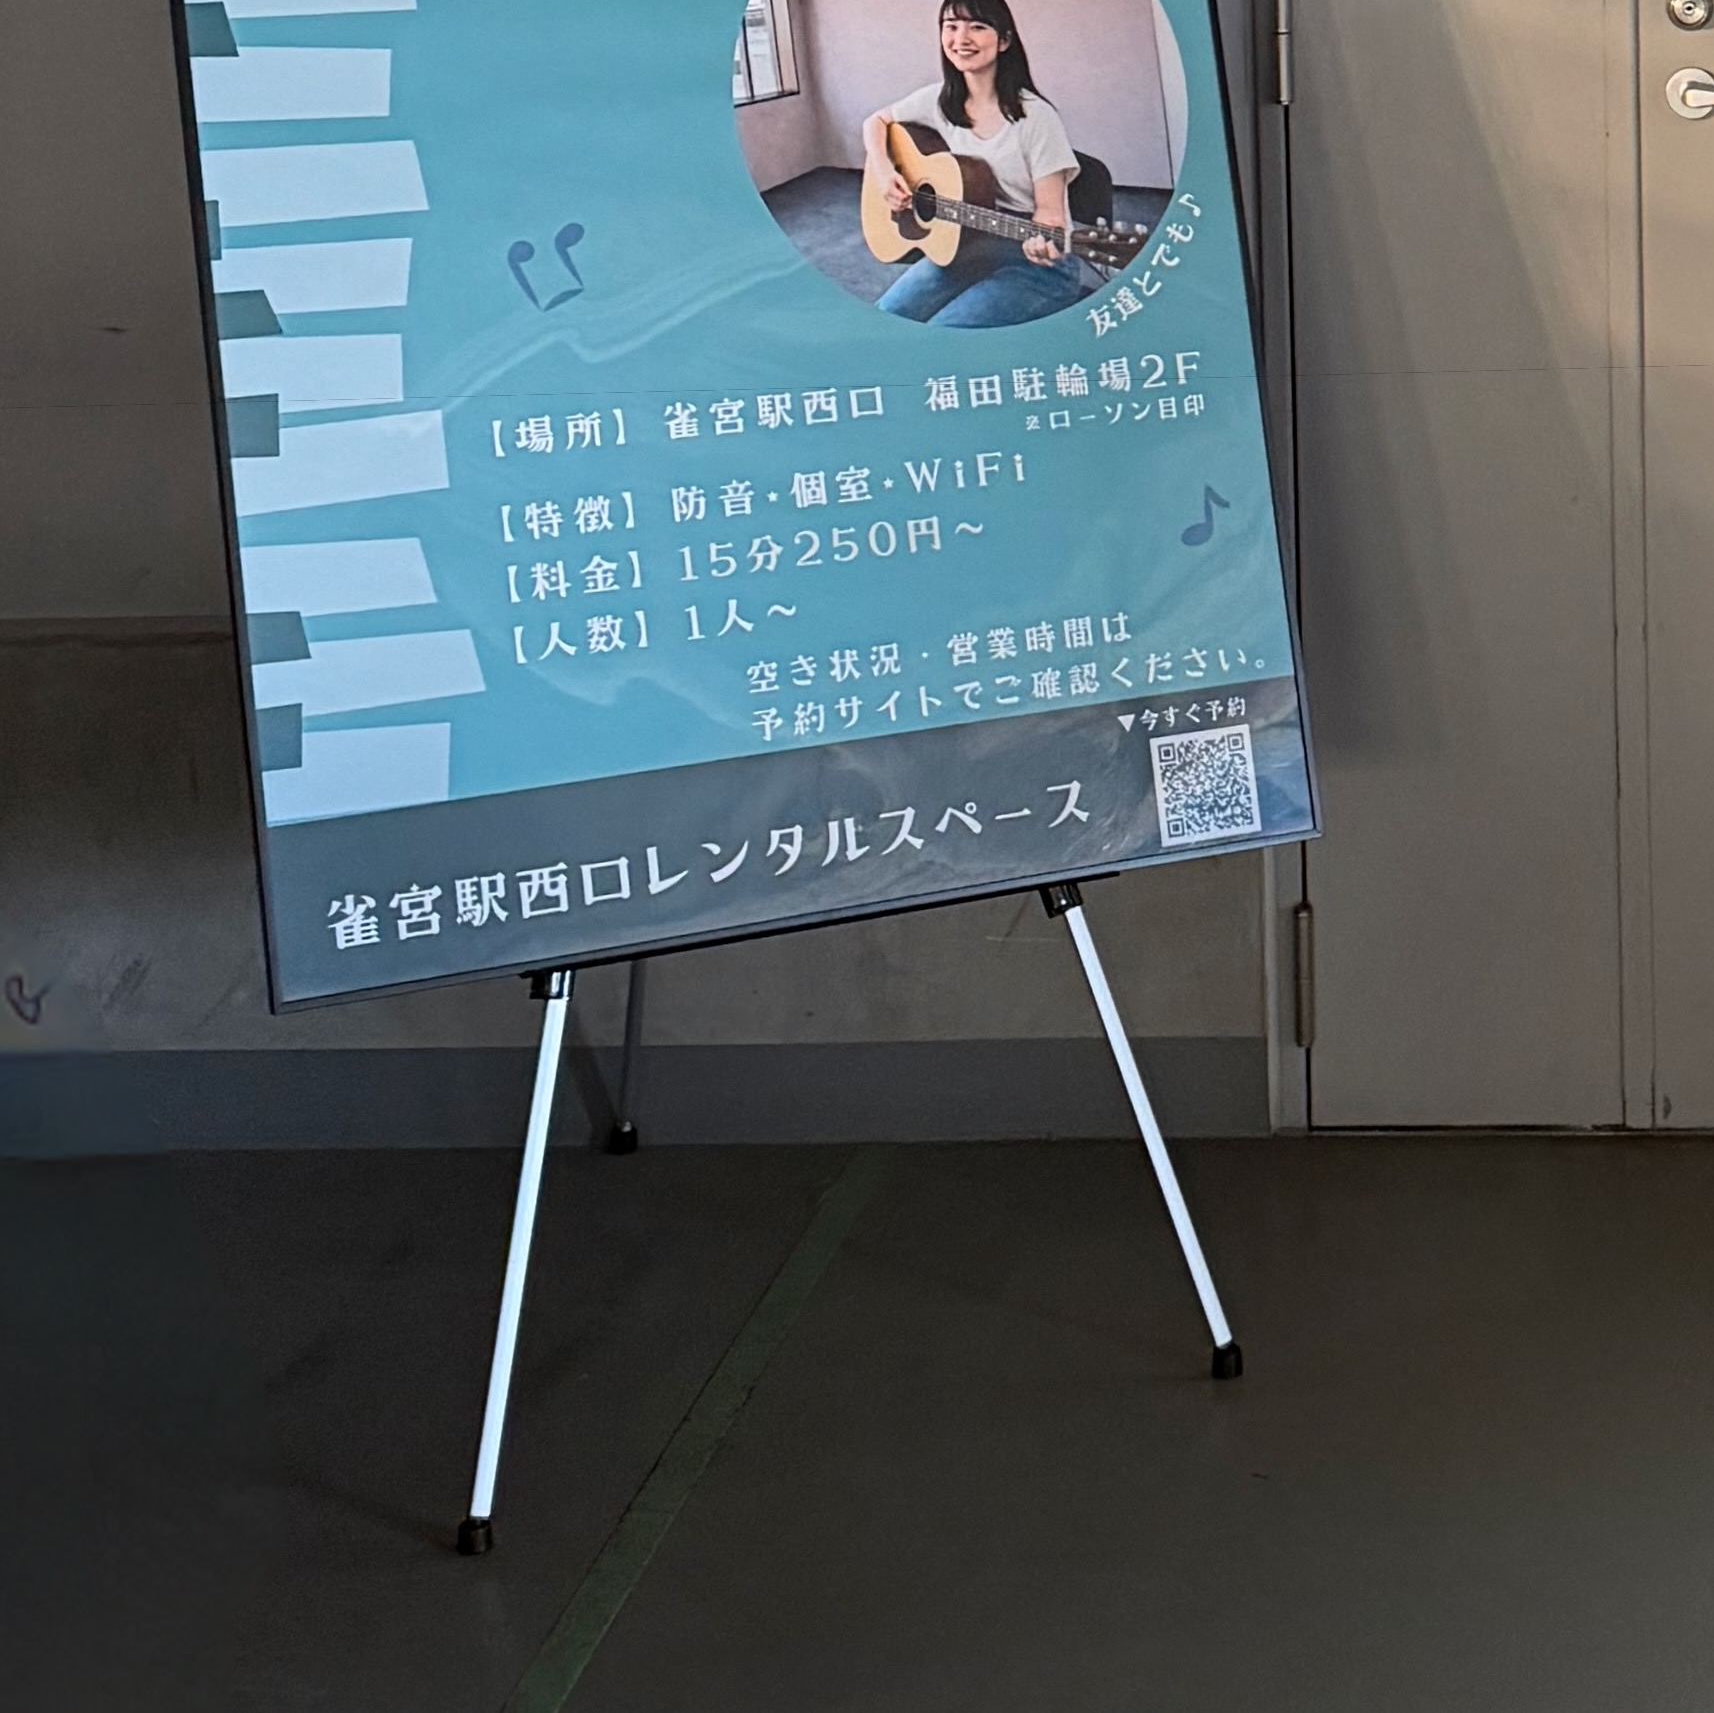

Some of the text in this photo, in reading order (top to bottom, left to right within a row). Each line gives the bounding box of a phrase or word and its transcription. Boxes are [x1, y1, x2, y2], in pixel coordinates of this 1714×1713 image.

[491, 350, 1201, 458] 【場所】 雀宮駅西口 福田駐輪場2F
[500, 491, 636, 543] 【特徴】
[507, 550, 642, 603] 【料金】
[513, 610, 649, 665] 【人数】
[745, 612, 1132, 696] 空き状況・営業時間は
[752, 646, 1267, 742] 予約サイトでご確認ください。
[324, 777, 1091, 950] 雀宮駅西口レンタルスペース
